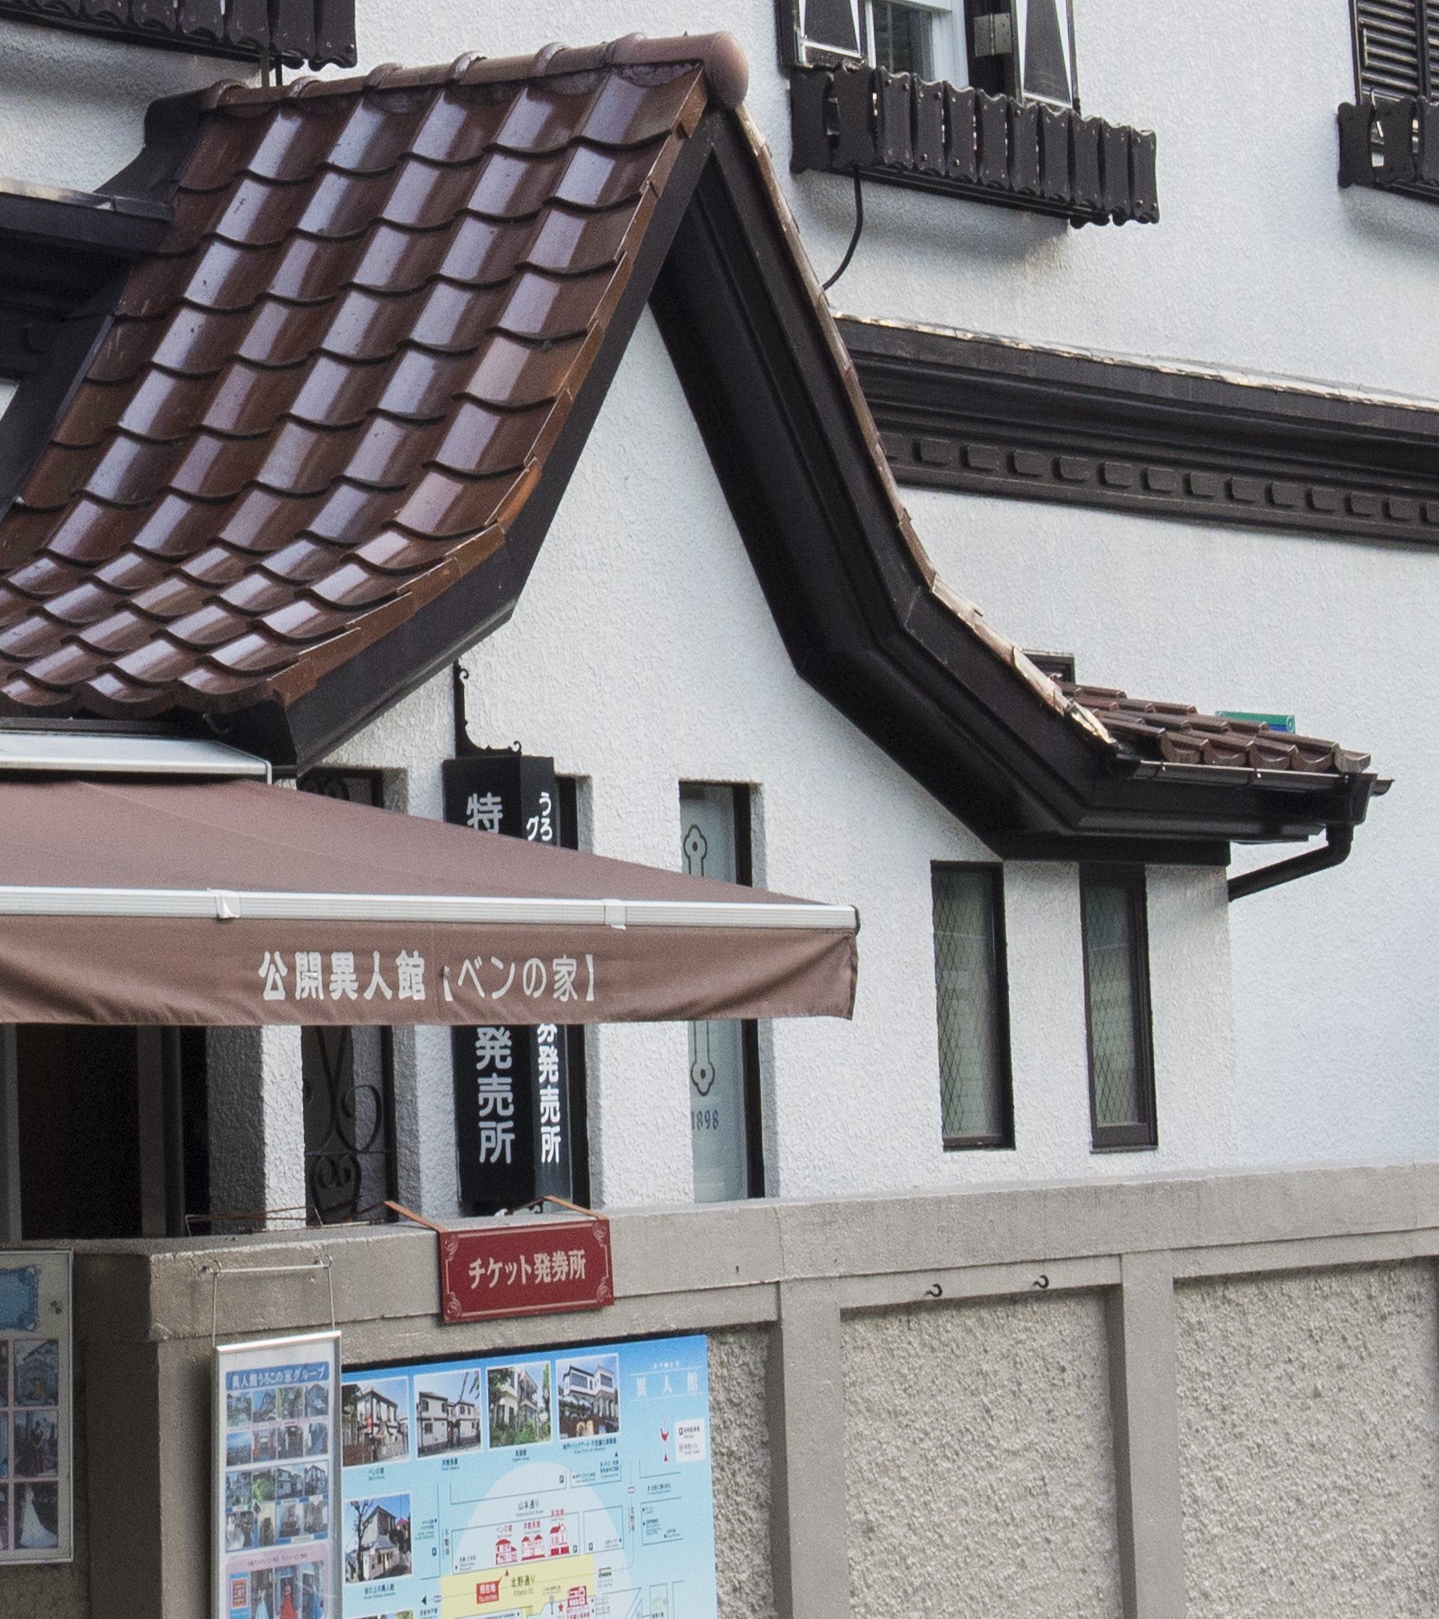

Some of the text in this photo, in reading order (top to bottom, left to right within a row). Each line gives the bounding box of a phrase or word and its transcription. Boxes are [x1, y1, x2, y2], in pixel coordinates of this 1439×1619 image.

[468, 1249, 587, 1291] チケット発券所
